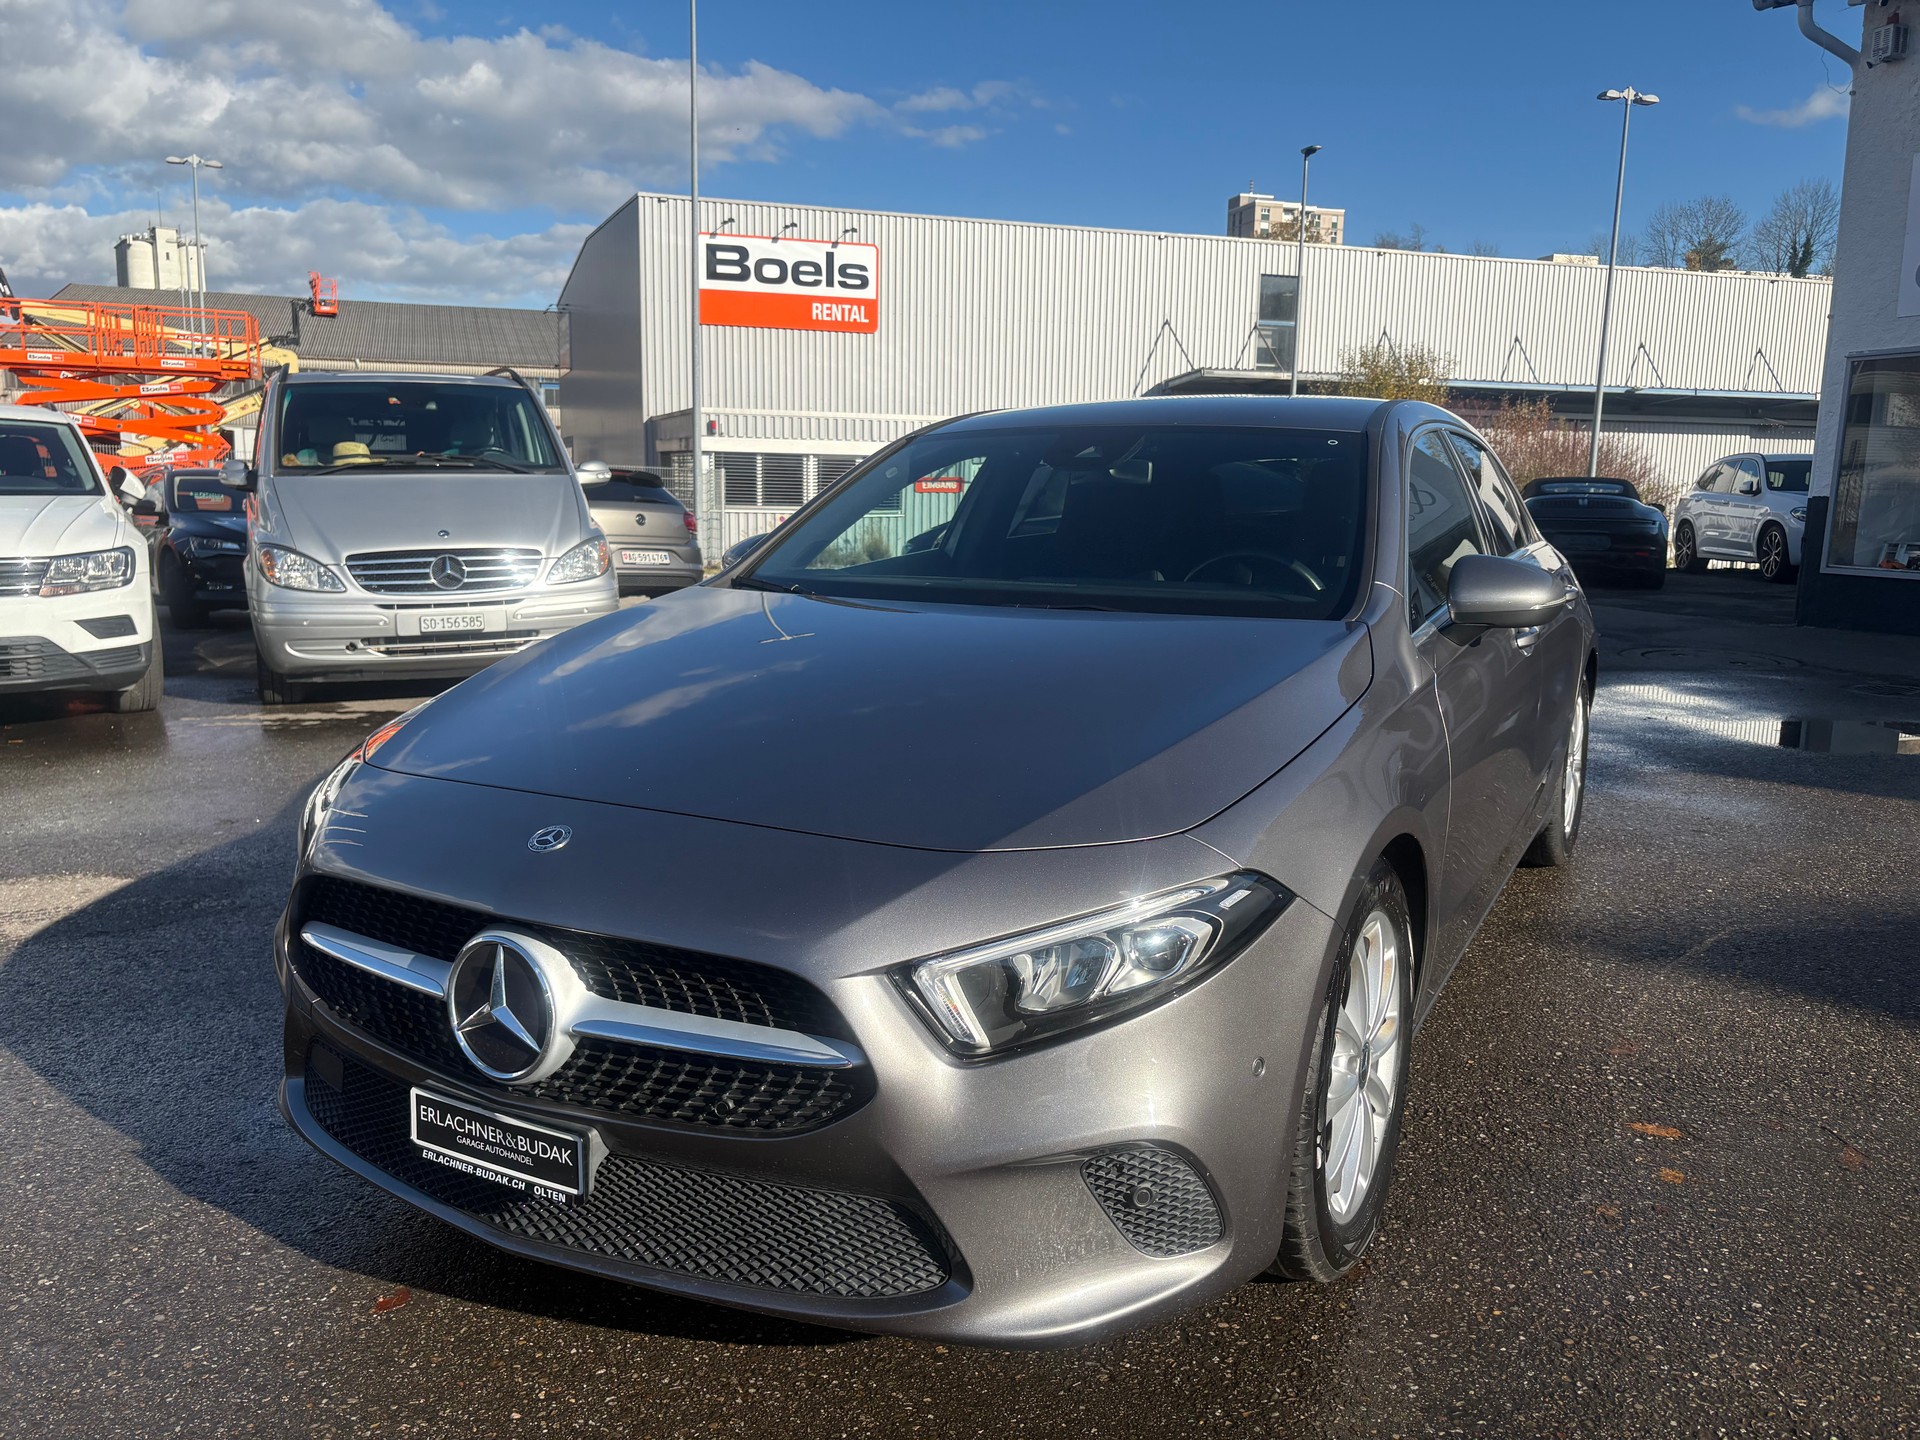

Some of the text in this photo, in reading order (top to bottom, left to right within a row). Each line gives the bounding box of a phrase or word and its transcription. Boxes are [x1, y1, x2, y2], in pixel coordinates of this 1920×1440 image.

[706, 243, 869, 290] Boels
[811, 302, 869, 323] RENTAL
[922, 481, 957, 489] EINGANG
[420, 1104, 574, 1167] ERLACHNER&BUDAK
[456, 1135, 534, 1167] GARAGE AUTOHANDEL
[422, 1149, 566, 1203] ERLACHNER-BUDAK.CH OLTEN
